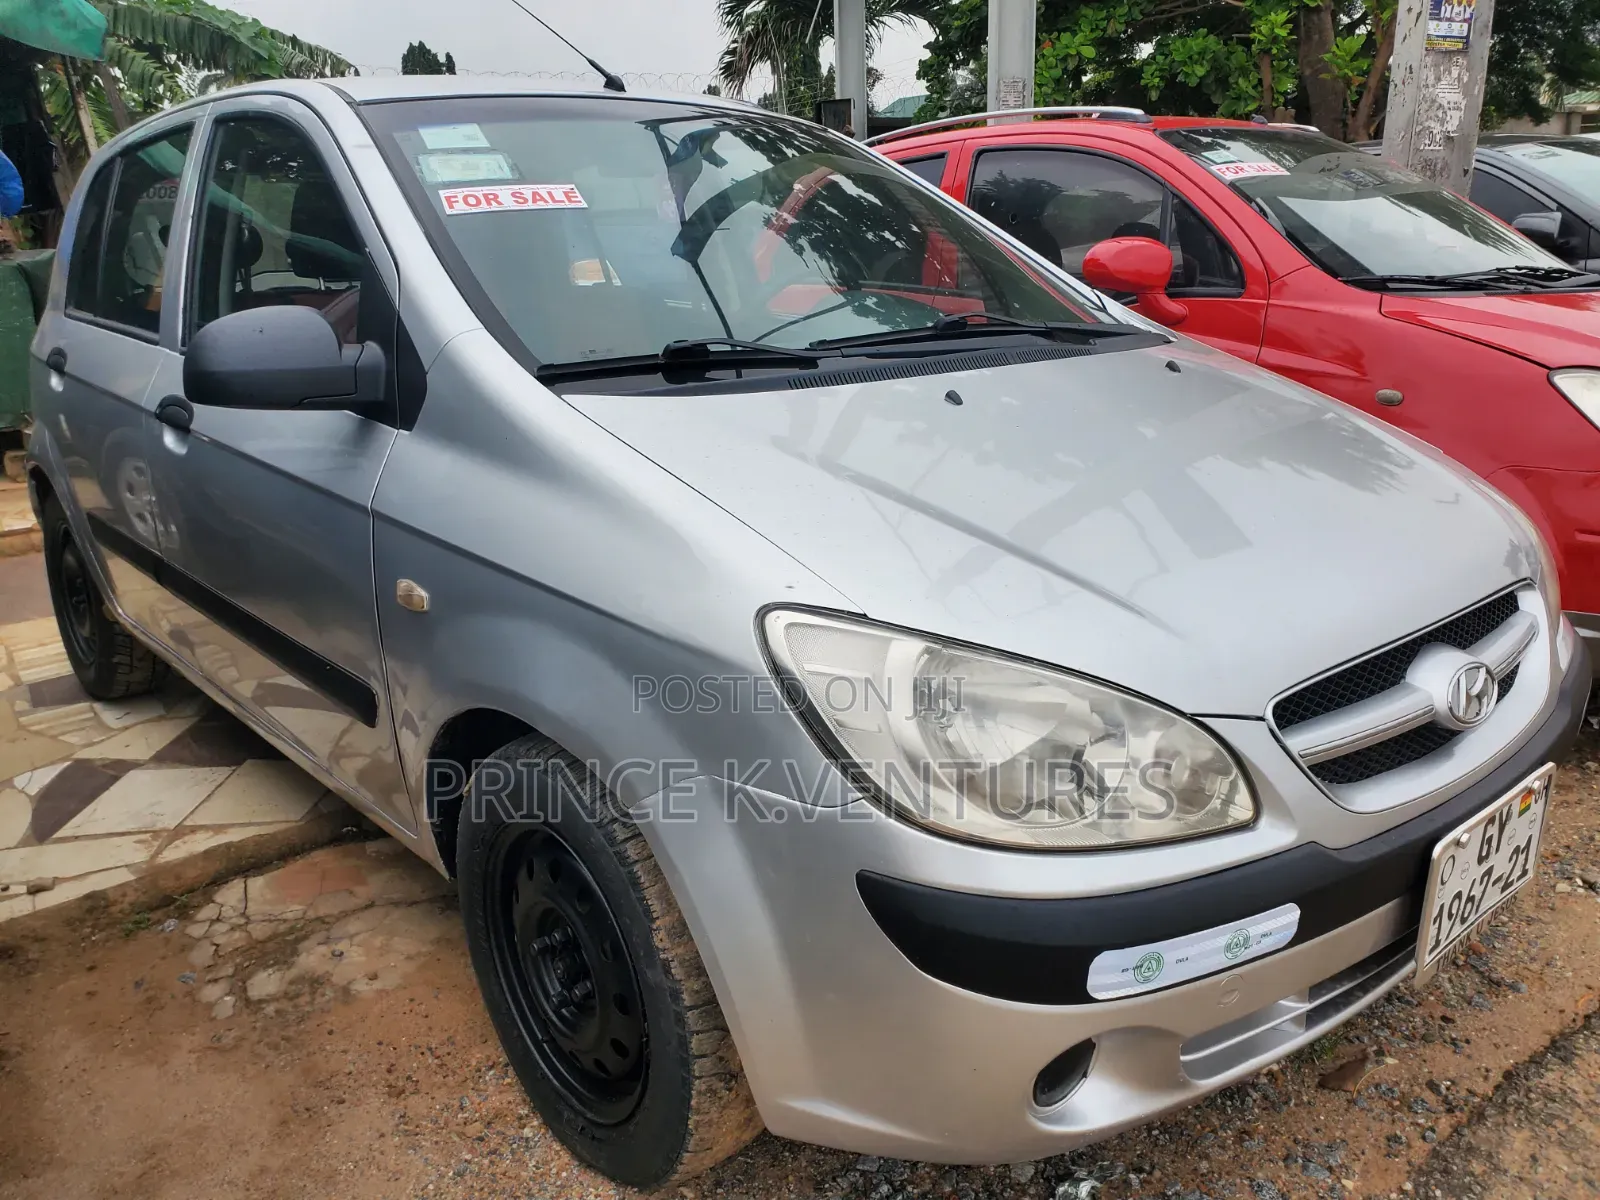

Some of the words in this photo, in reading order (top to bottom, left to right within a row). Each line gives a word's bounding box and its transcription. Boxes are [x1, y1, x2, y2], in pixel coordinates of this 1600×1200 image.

[1216, 165, 1247, 177] FOR
[1250, 163, 1286, 174] SALE
[444, 192, 505, 210] FOR
[511, 190, 583, 206] SALE
[1477, 803, 1513, 866] GY
[1429, 834, 1533, 956] 1967-21
